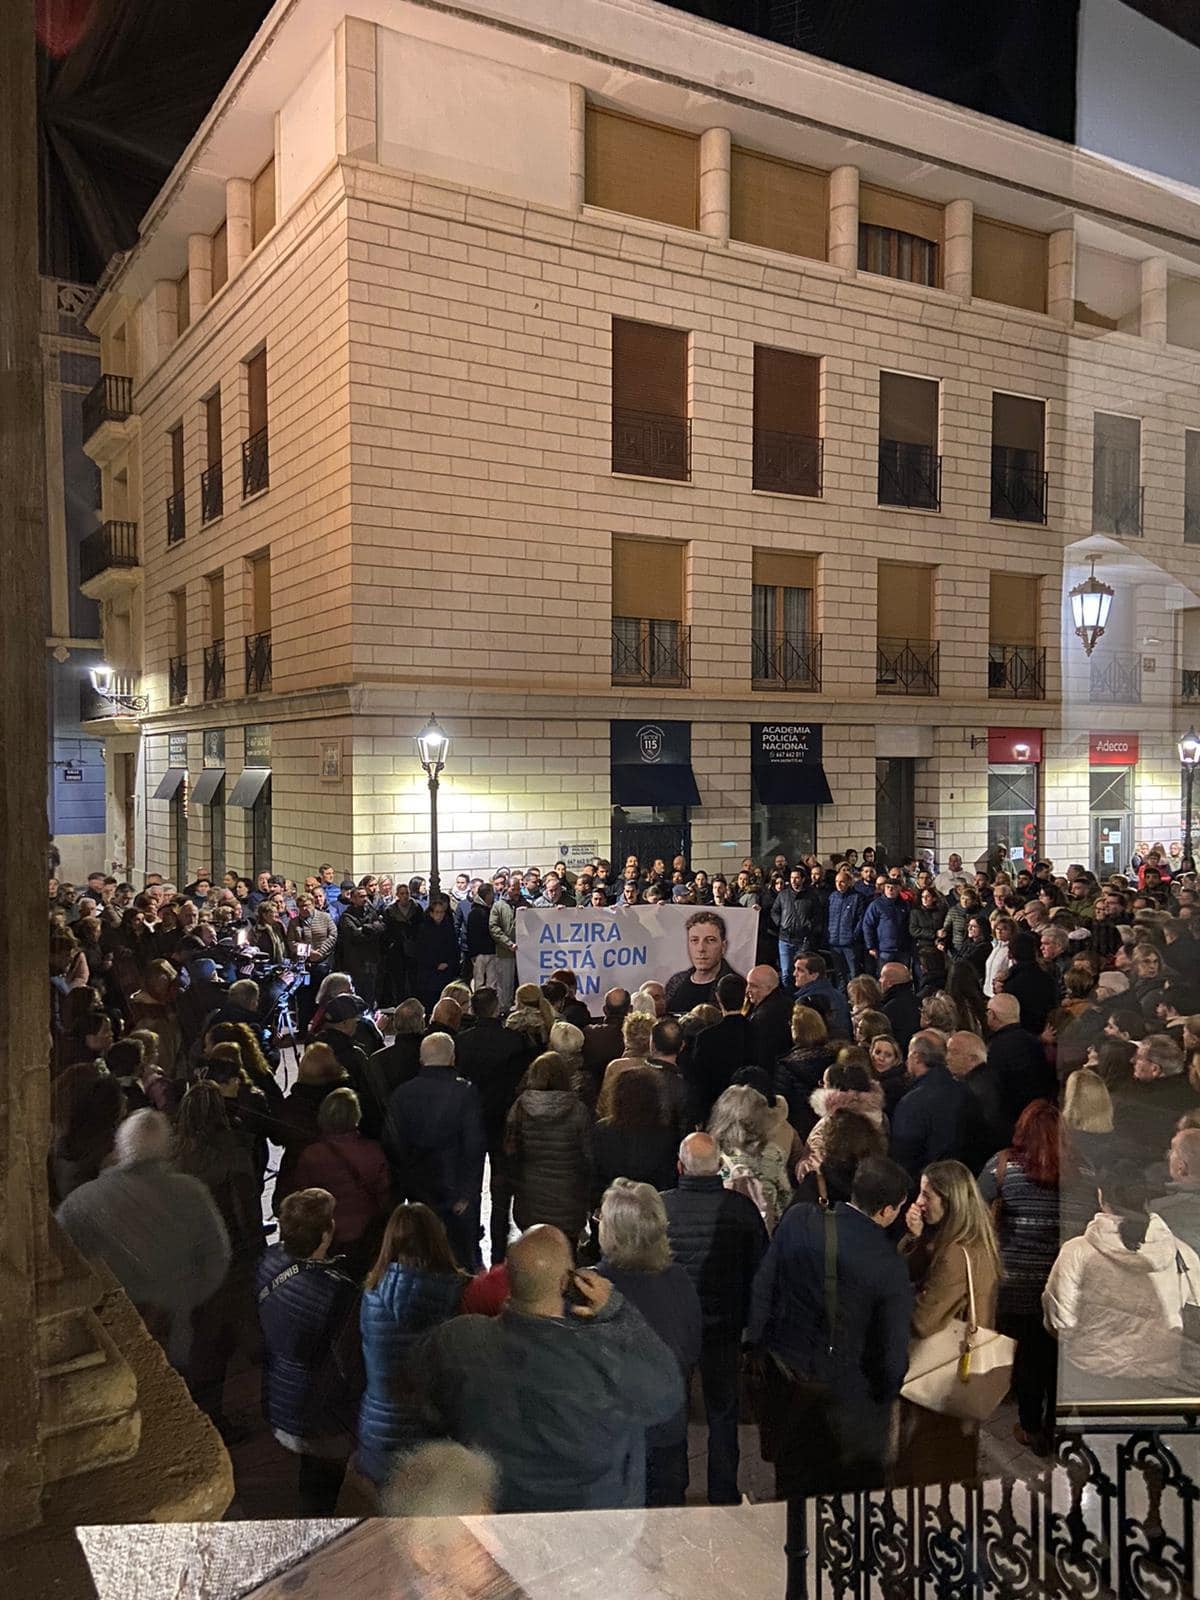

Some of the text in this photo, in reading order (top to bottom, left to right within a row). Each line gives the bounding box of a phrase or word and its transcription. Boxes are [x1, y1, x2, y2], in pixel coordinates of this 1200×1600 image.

[762, 726, 811, 734] ACADEMIA
[644, 740, 658, 749] 115
[1095, 740, 1129, 752] Adecco
[539, 923, 622, 943] ALZIRA
[540, 944, 647, 969] ESTÁ CON
[539, 975, 601, 995] AN
